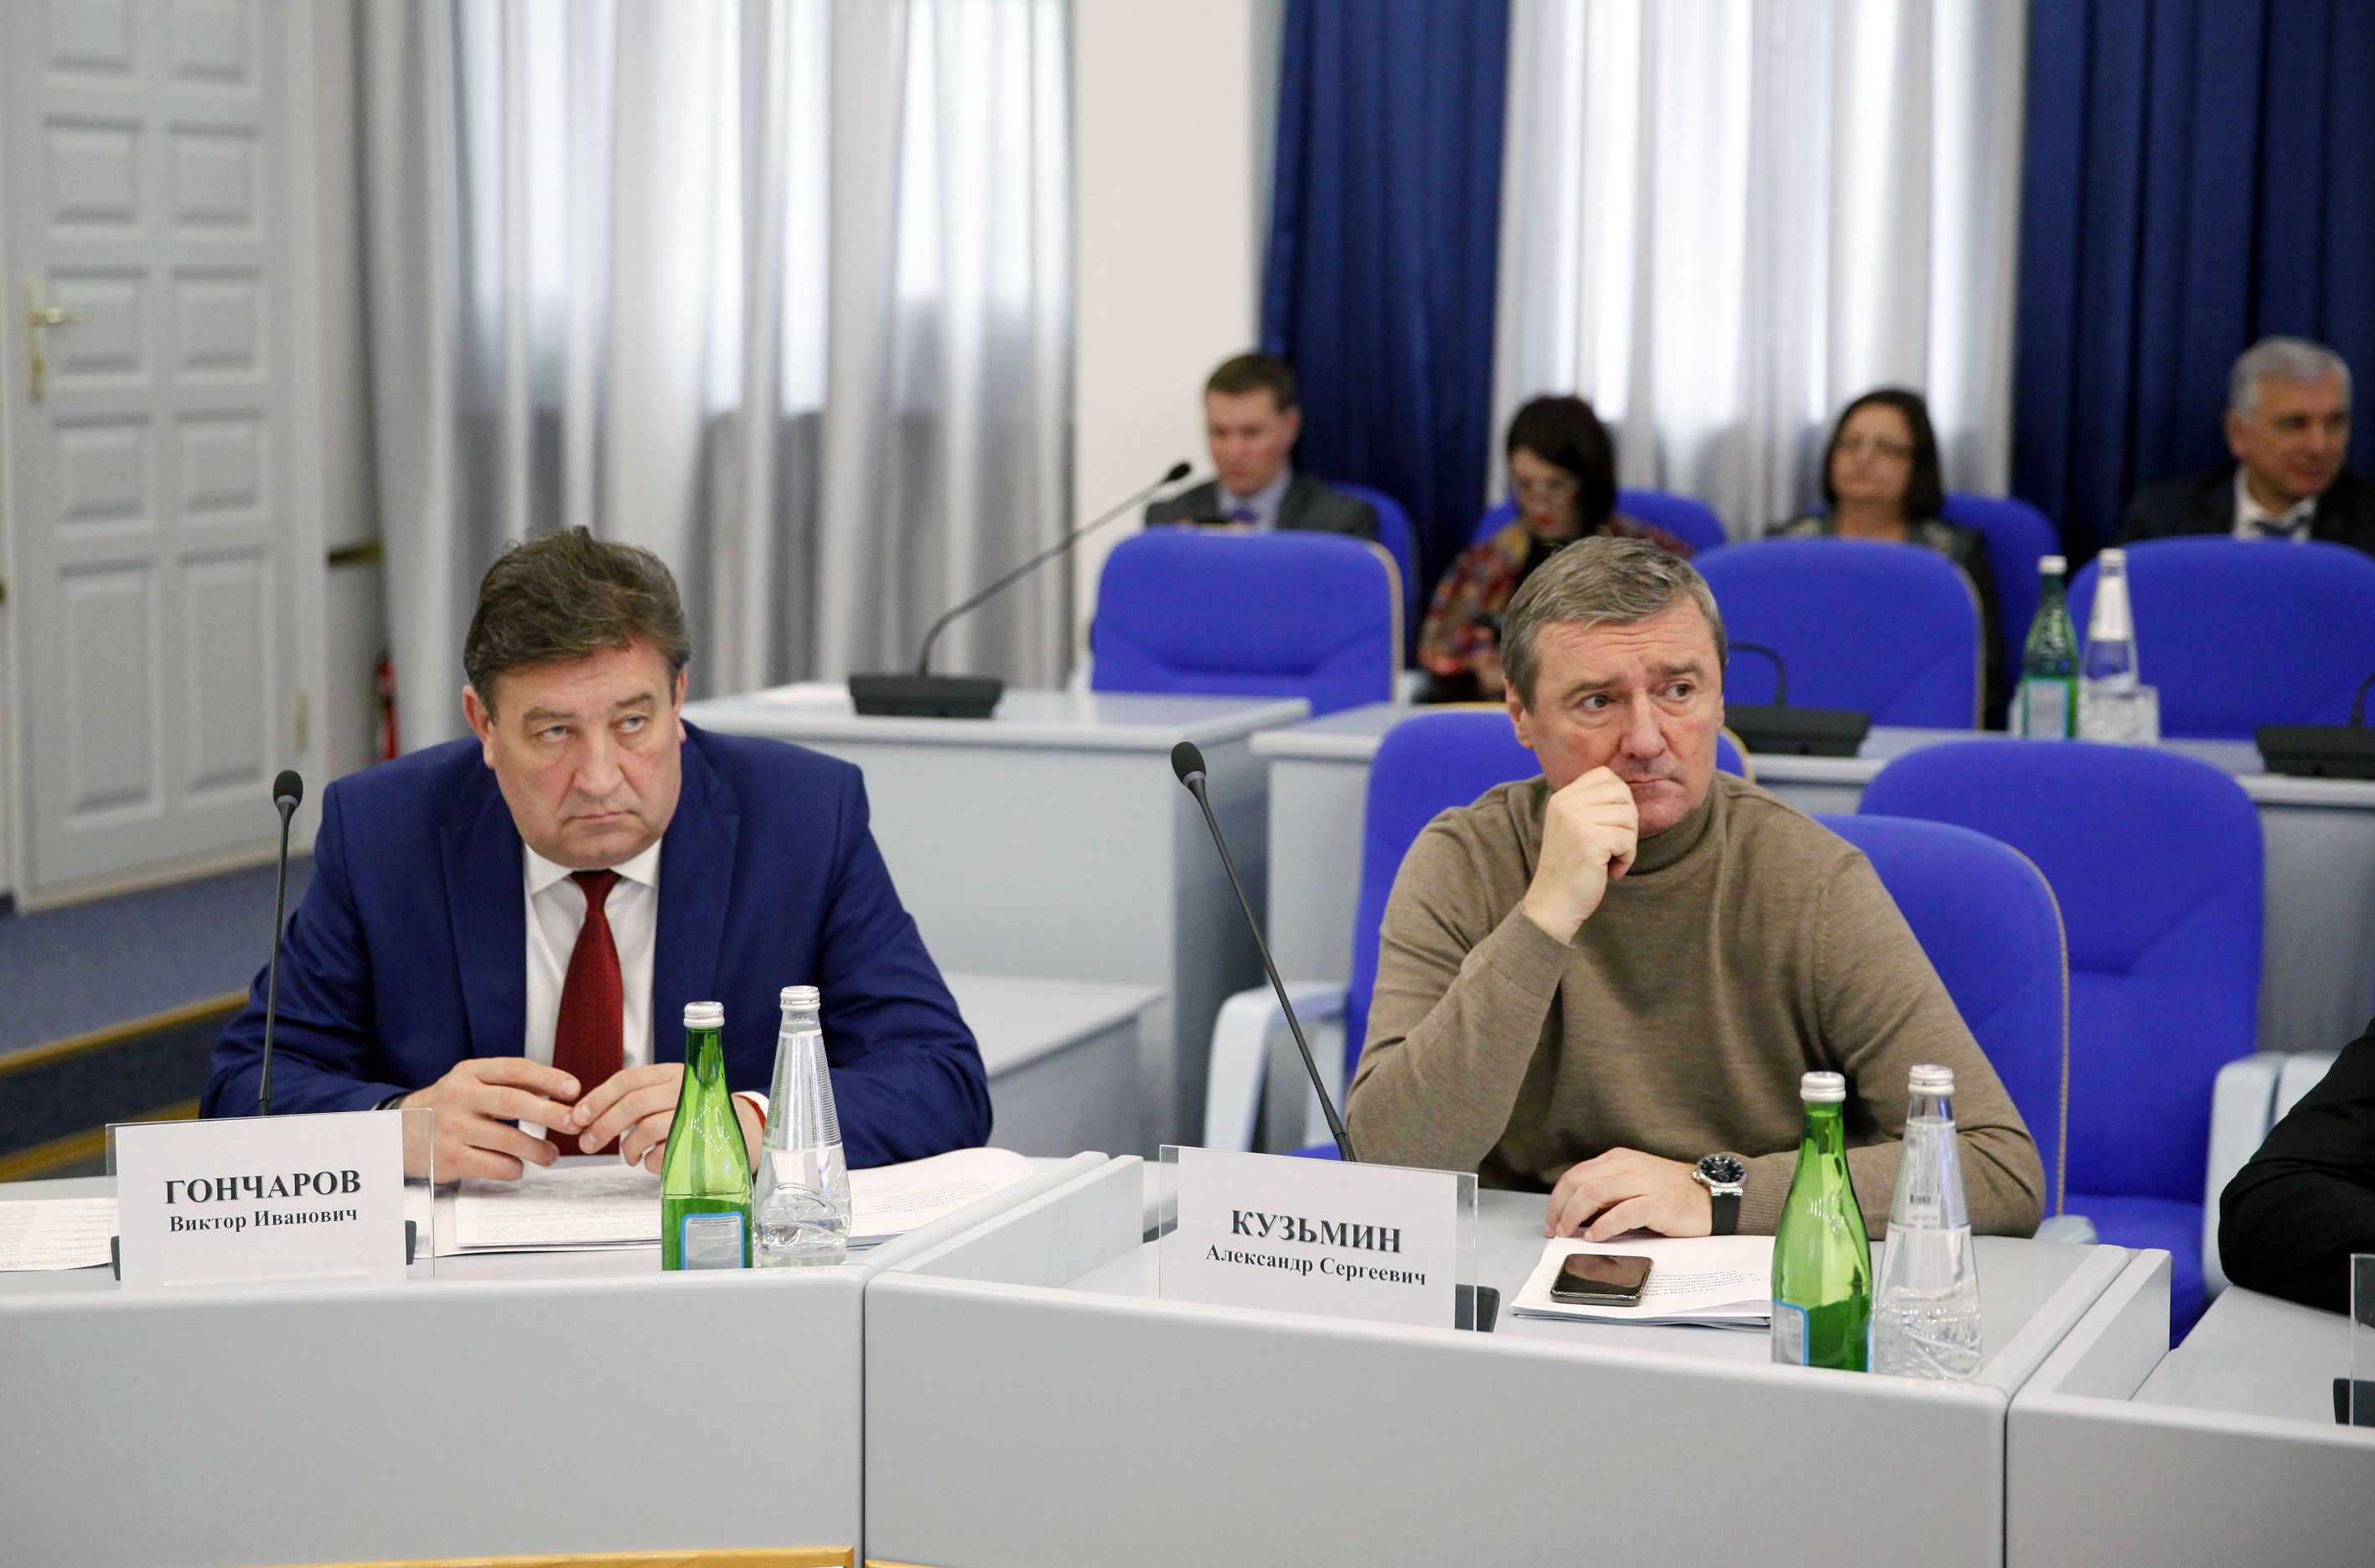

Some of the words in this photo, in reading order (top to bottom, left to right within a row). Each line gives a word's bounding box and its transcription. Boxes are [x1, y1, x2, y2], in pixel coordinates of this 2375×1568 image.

[164, 1170, 361, 1204] ГОНЧАРОВ
[169, 1215, 246, 1232] Виктор
[254, 1209, 358, 1227] Иванович
[1230, 1209, 1403, 1254] КУЗЬМИН
[1206, 1245, 1313, 1276] Александр
[1319, 1257, 1426, 1286] Сергеевич
